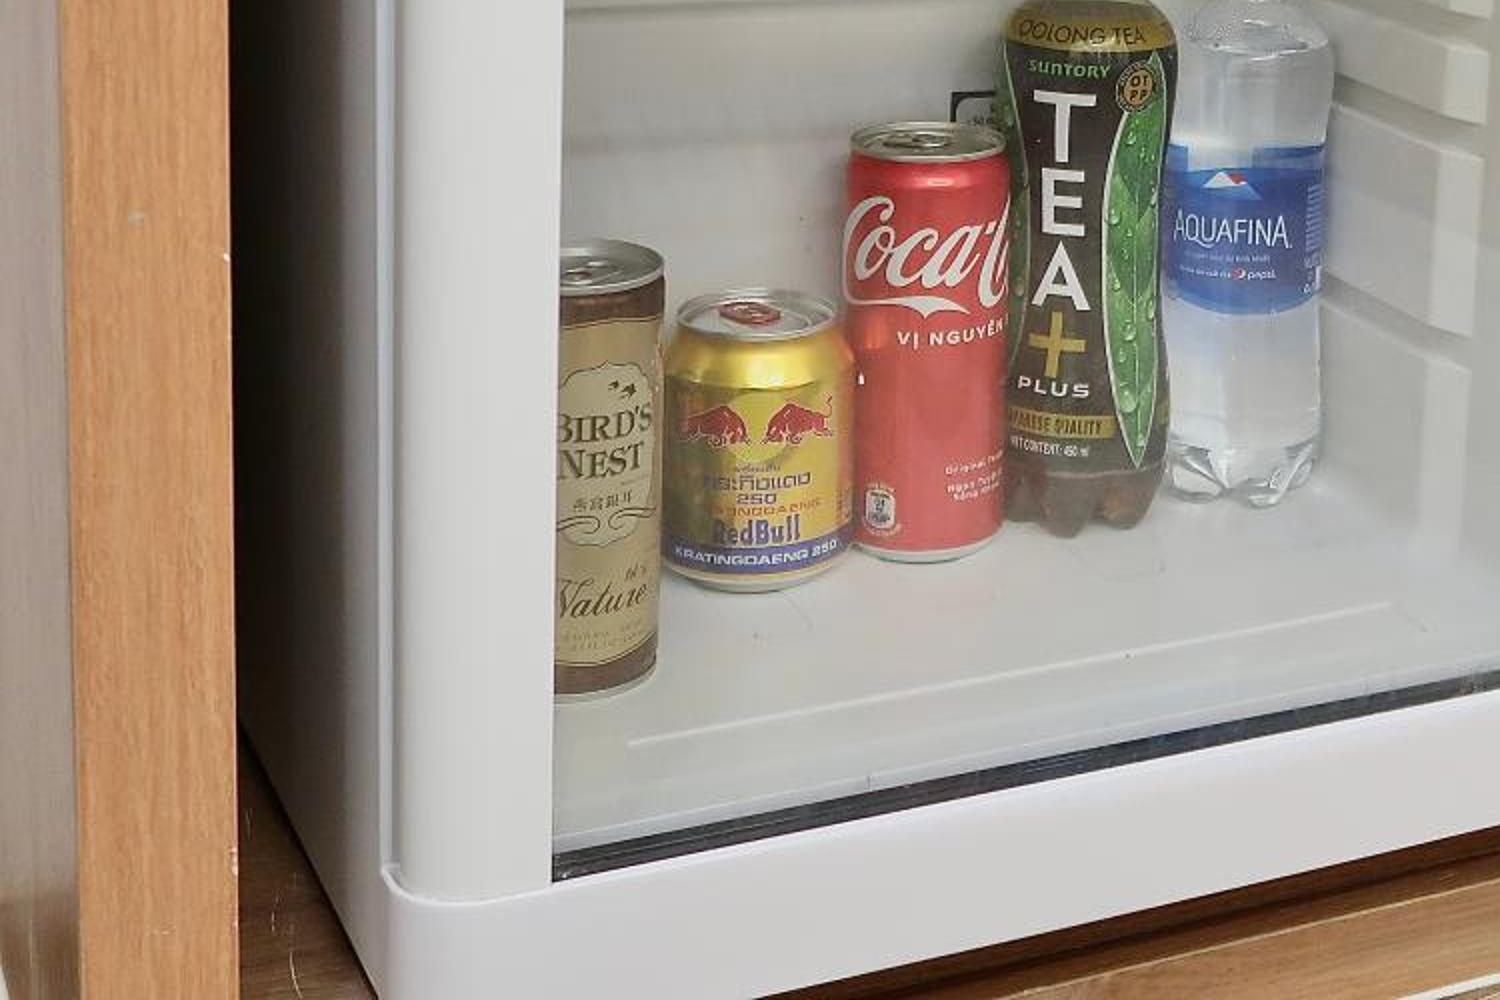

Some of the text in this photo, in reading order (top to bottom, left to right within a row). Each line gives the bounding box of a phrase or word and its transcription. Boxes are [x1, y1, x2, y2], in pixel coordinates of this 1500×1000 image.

[1018, 19, 1146, 45] OOLONG TEA
[1173, 208, 1290, 249] AQUAFINA
[1017, 375, 1090, 399] PLUS
[557, 402, 652, 444] BIRD'S
[557, 441, 644, 480] NEST
[736, 493, 777, 505] 250
